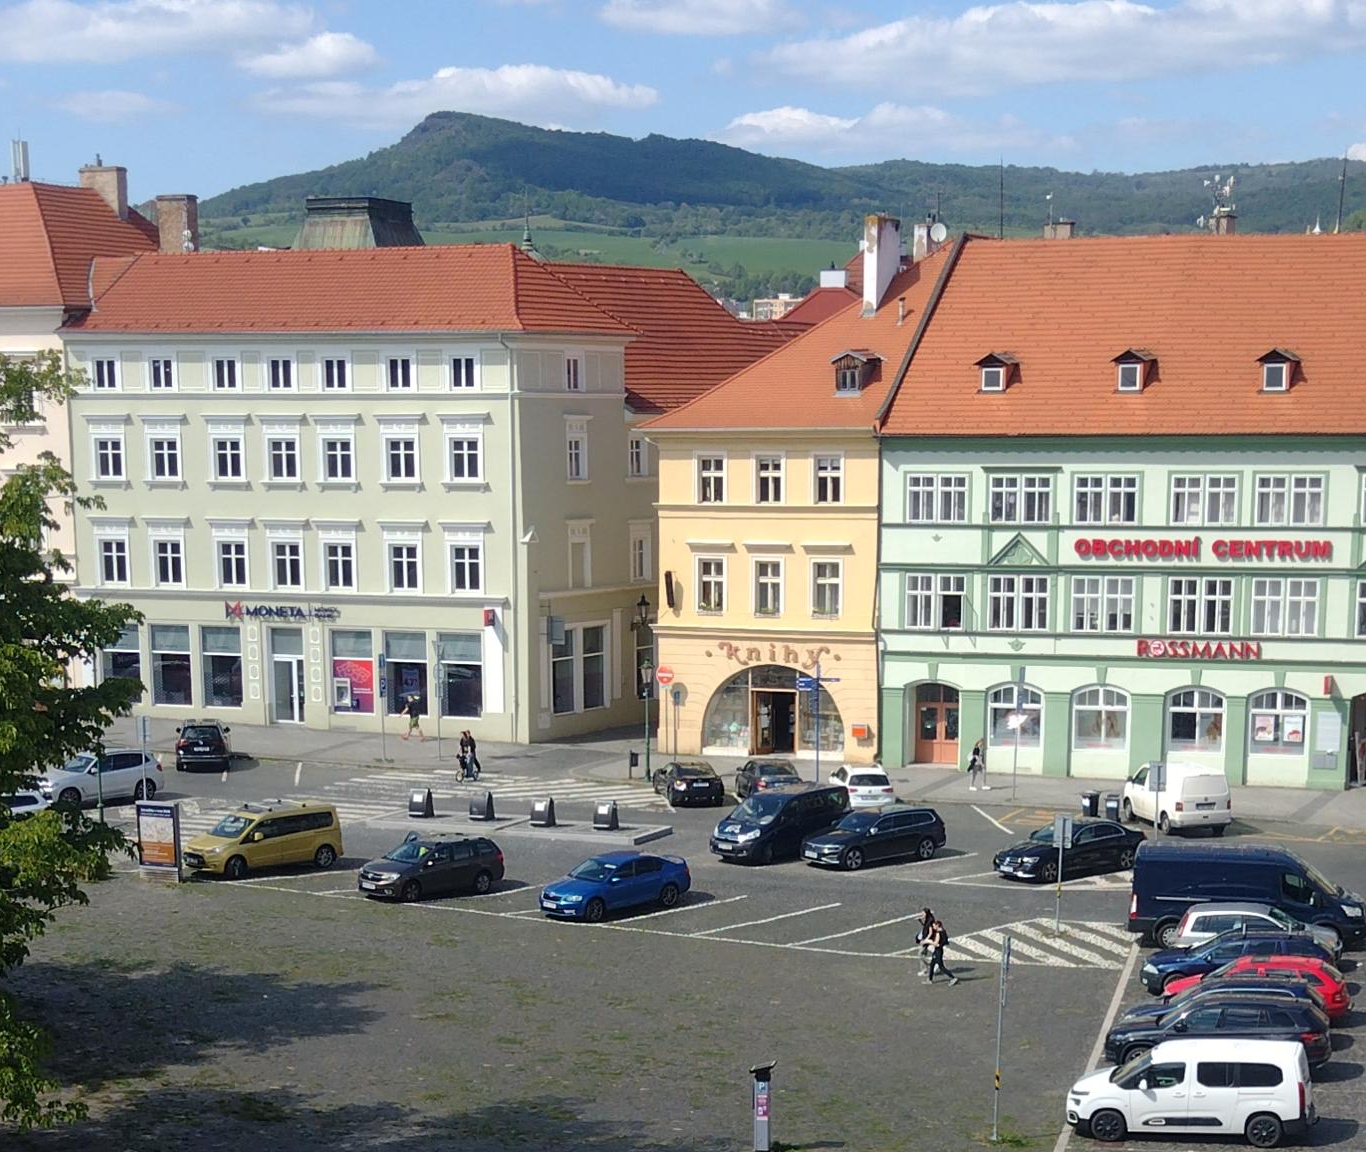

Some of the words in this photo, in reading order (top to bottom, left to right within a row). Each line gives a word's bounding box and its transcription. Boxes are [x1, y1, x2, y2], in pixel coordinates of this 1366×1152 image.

[1073, 536, 1202, 560] OBCHODNÍ
[1211, 539, 1333, 561] CENTRUM
[246, 605, 306, 618] MONETA
[718, 641, 831, 669] knihy
[1137, 639, 1262, 659] ROSSMANN
